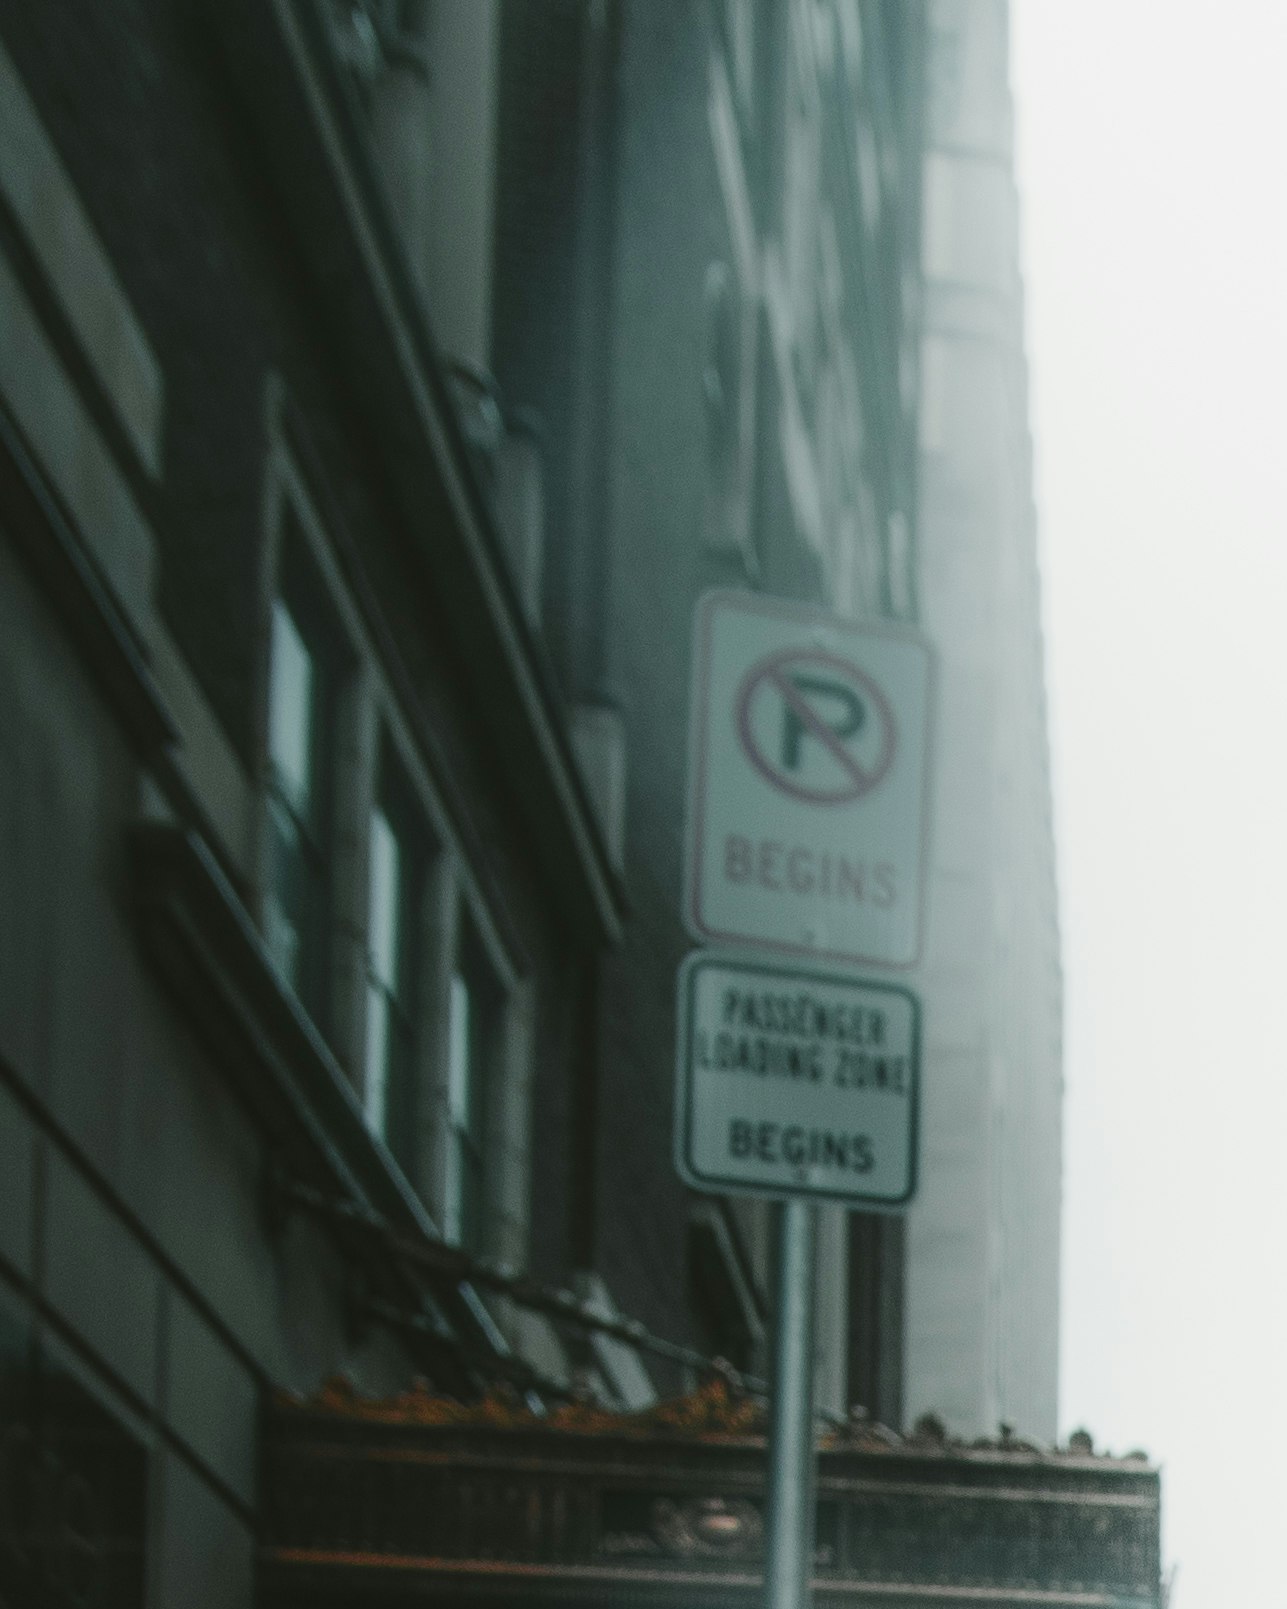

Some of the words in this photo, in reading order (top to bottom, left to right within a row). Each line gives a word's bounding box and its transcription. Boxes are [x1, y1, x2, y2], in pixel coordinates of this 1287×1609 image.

[721, 832, 898, 911] BEGINS
[723, 988, 886, 1045] PASSENGER
[697, 1030, 823, 1083] LOADING
[834, 1047, 907, 1096] ZONE
[727, 1117, 876, 1174] BEGINS
